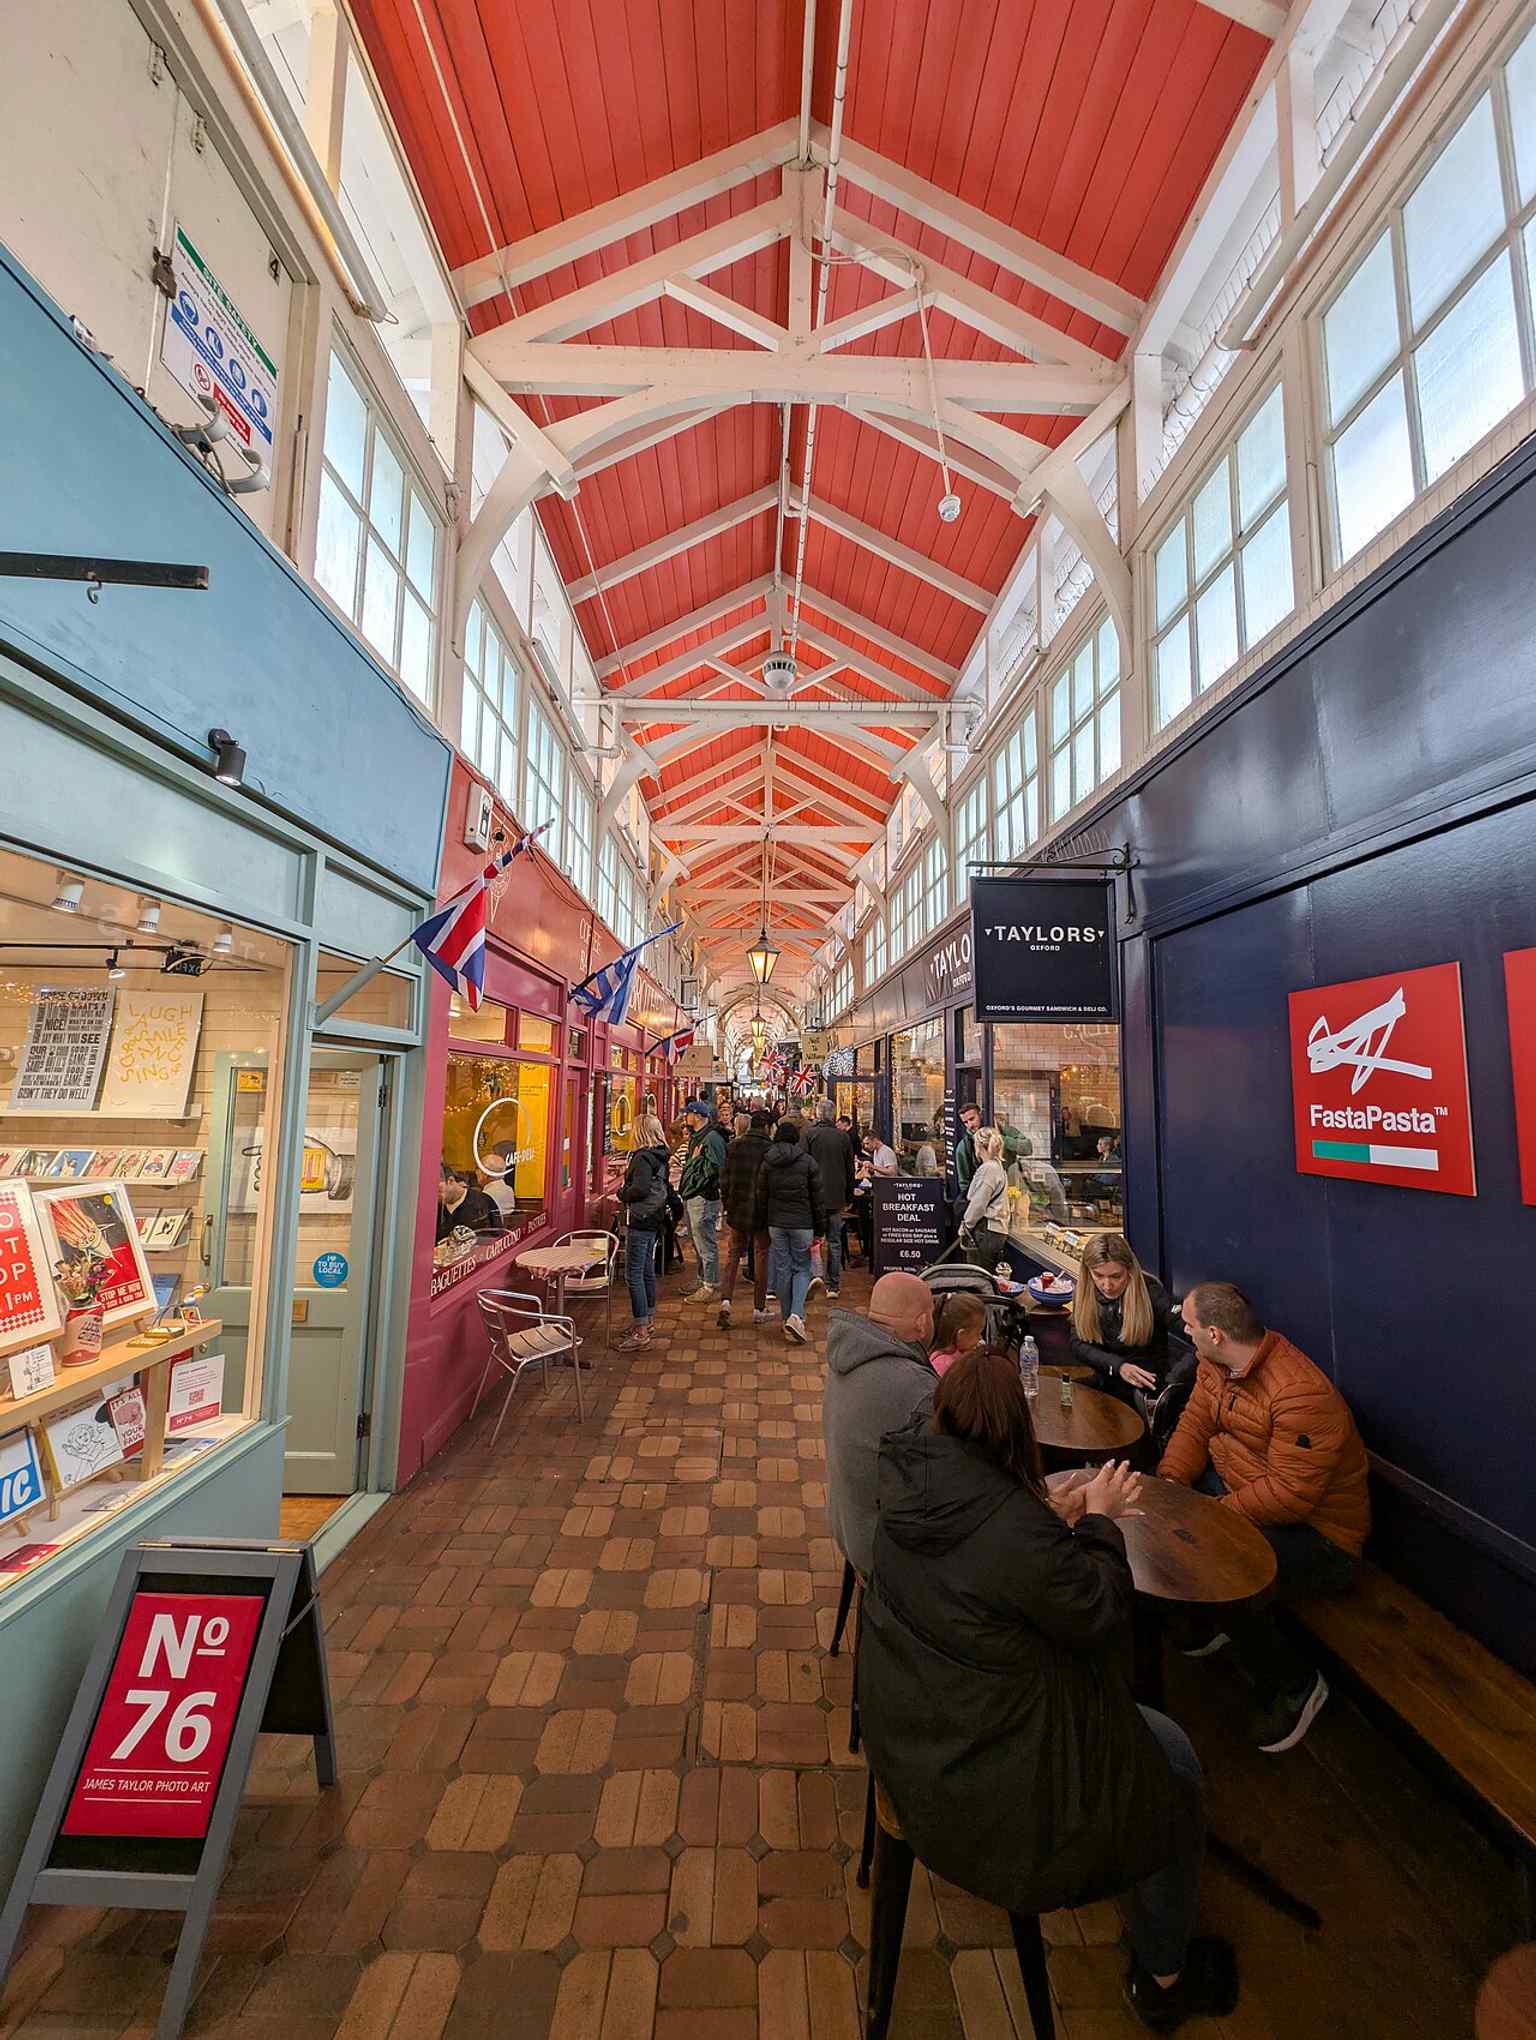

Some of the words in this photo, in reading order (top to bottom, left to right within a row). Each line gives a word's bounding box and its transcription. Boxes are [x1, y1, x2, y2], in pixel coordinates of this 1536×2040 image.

[994, 925, 1096, 942] TAYLORS
[933, 933, 971, 979] TAYLO
[80, 1033, 101, 1044] SEE
[40, 1088, 58, 1099] THEY
[897, 1193, 917, 1201] HOT
[882, 1203, 935, 1212] BREAKFAST
[897, 1213, 921, 1222] DEAL
[900, 1250, 921, 1258] £6.50
[430, 1256, 476, 1297] BAGUETTES
[486, 1228, 521, 1260] CAPPUCCINO
[100, 1289, 117, 1302] STOP
[121, 1424, 144, 1440] YOUR
[123, 1433, 144, 1447] FAUL
[109, 1689, 217, 1763] 76
[83, 1778, 114, 1791] JAMES
[117, 1779, 153, 1792] TAYLOR
[155, 1780, 189, 1792] PHOTO
[190, 1781, 210, 1793] ART
